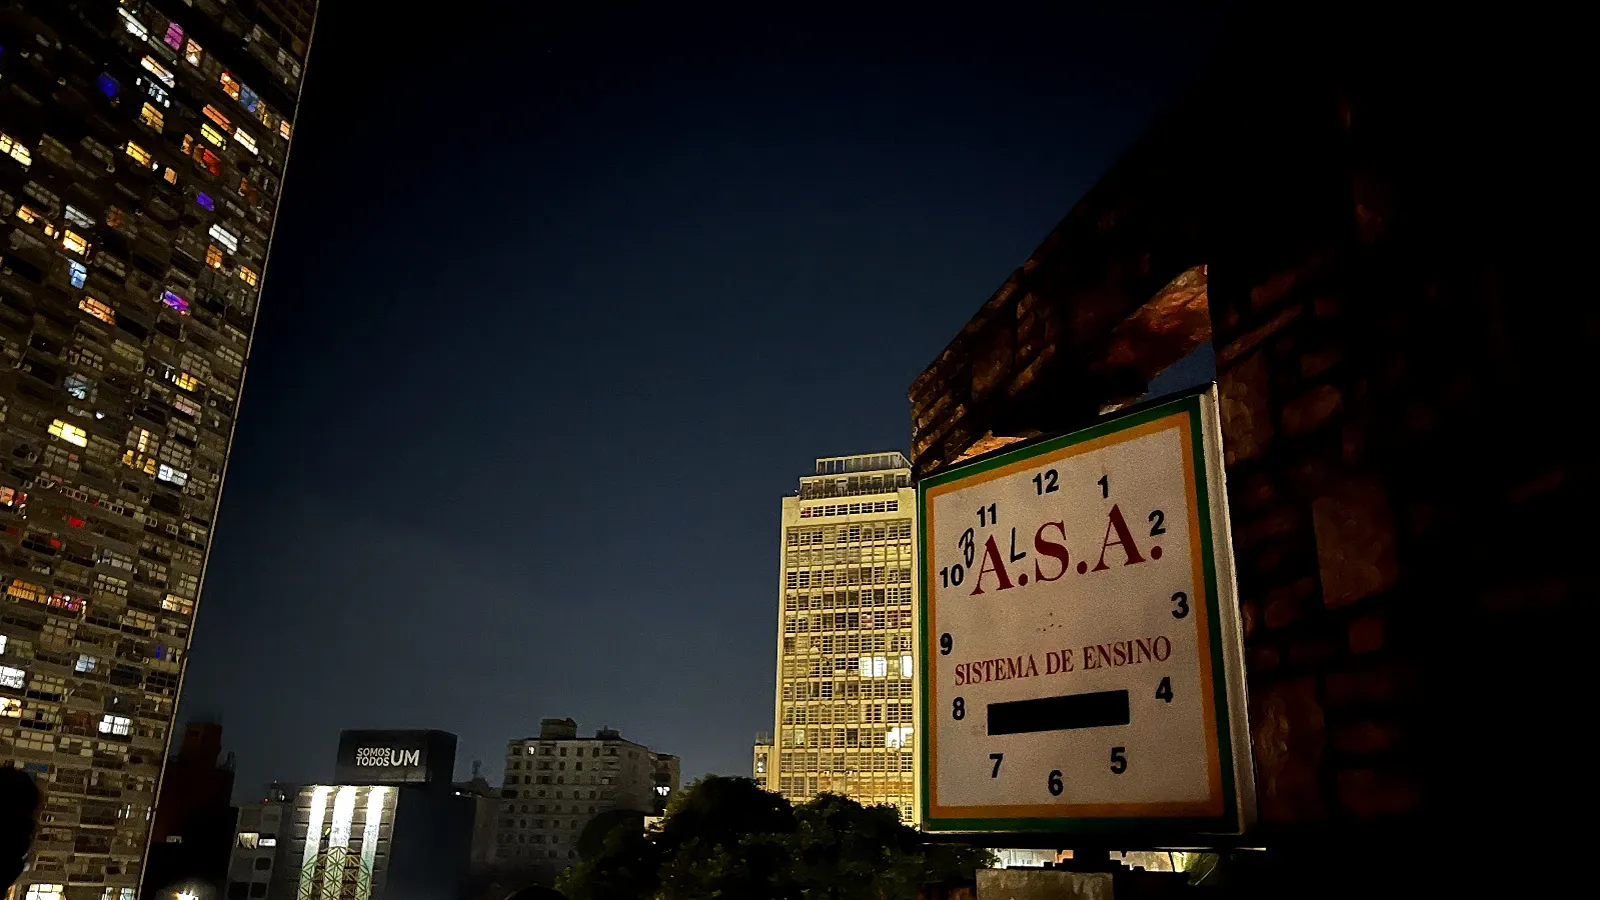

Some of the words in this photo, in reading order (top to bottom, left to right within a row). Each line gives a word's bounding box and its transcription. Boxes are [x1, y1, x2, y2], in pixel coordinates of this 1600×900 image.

[1032, 469, 1060, 496] 12
[1097, 474, 1109, 499] 1
[976, 502, 997, 528] 11
[1148, 509, 1166, 537] 2
[969, 503, 1164, 596] A.S.A.
[939, 563, 965, 589] 10
[1170, 591, 1190, 619] 3
[939, 632, 954, 656] 9
[954, 653, 1040, 687] SISTEMA
[1045, 648, 1074, 676] DE
[1083, 635, 1172, 671] ENSINO
[1155, 676, 1174, 704] 4
[952, 696, 966, 721] 8
[356, 747, 391, 757] SOMOS
[356, 756, 390, 767] TODOS
[390, 749, 420, 767] UM
[1110, 746, 1128, 775] 5
[988, 753, 1004, 779] 7
[1047, 769, 1064, 797] 6
